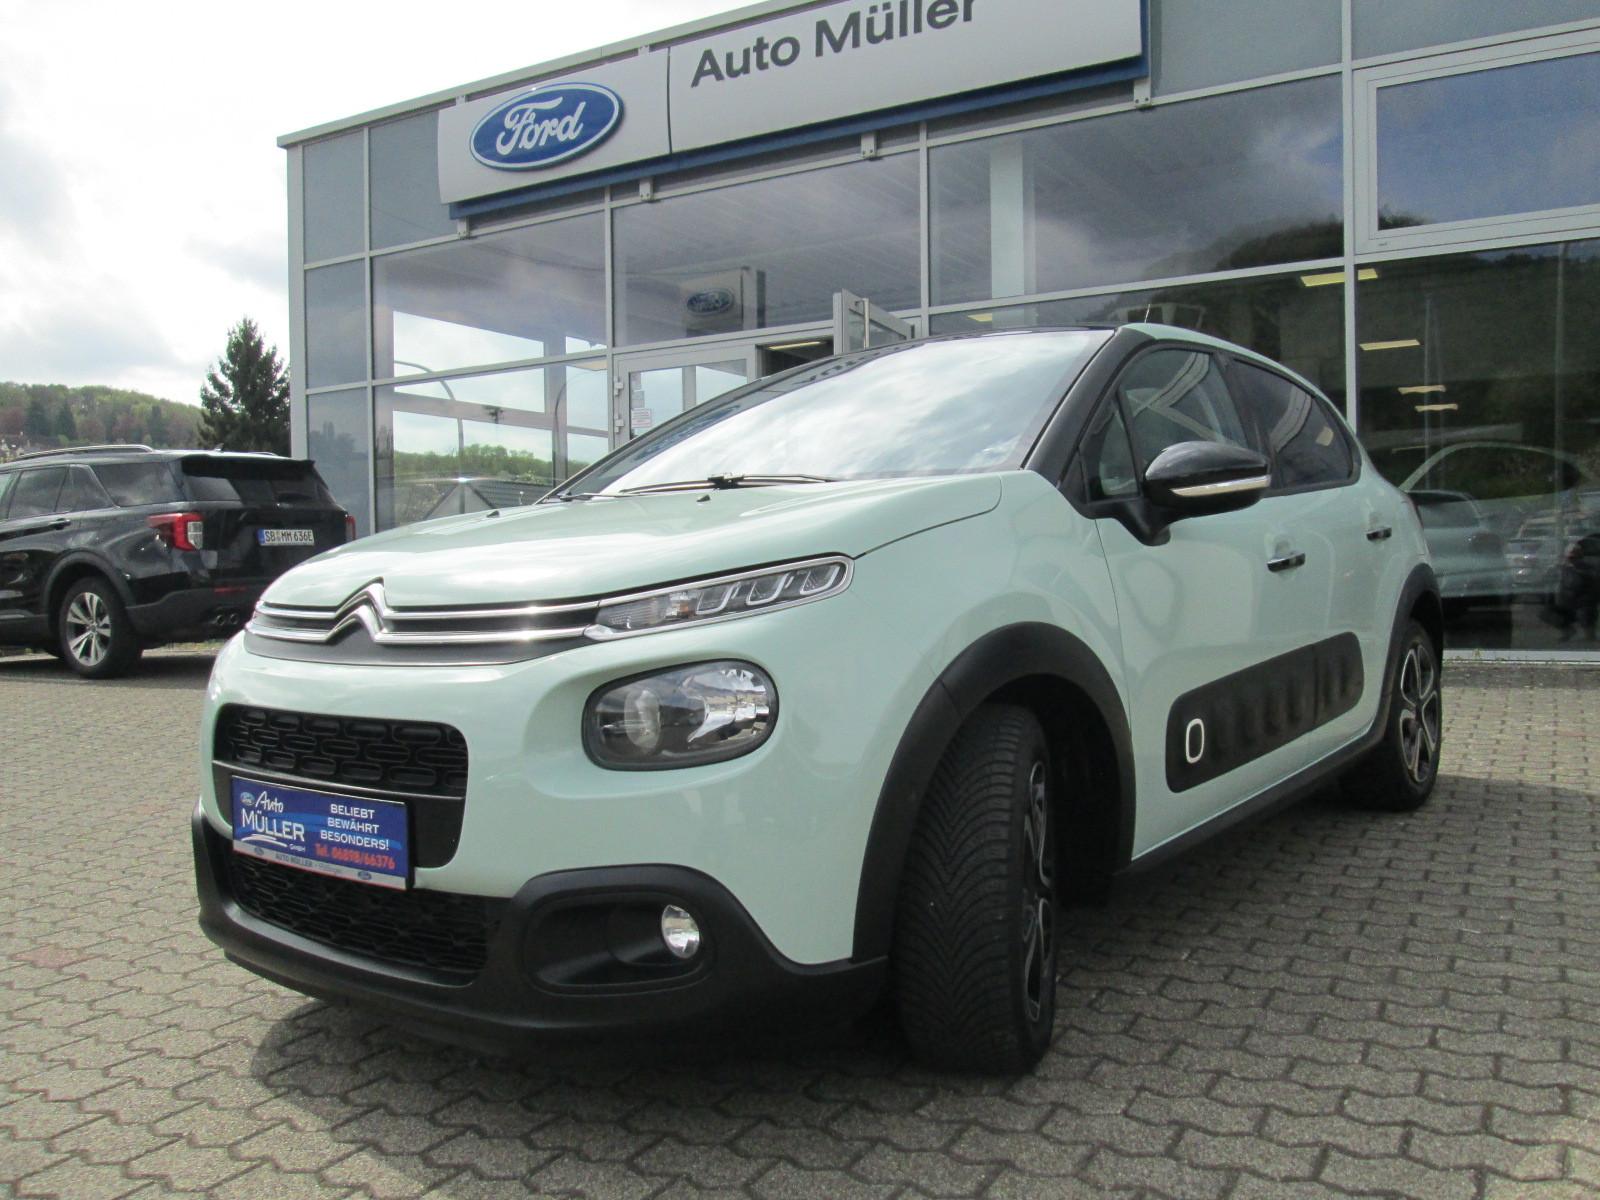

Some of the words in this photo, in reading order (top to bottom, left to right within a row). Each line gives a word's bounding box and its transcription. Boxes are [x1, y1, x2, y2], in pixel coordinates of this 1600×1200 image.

[690, 36, 801, 89] Auto
[814, 0, 974, 57] Müller
[496, 96, 586, 156] Ford
[255, 790, 284, 813] Auto
[330, 803, 375, 819] BELIEBT
[241, 807, 305, 842] MÜLLER
[327, 817, 380, 834] BEWÄHRT
[320, 829, 390, 851] BESONDERS!
